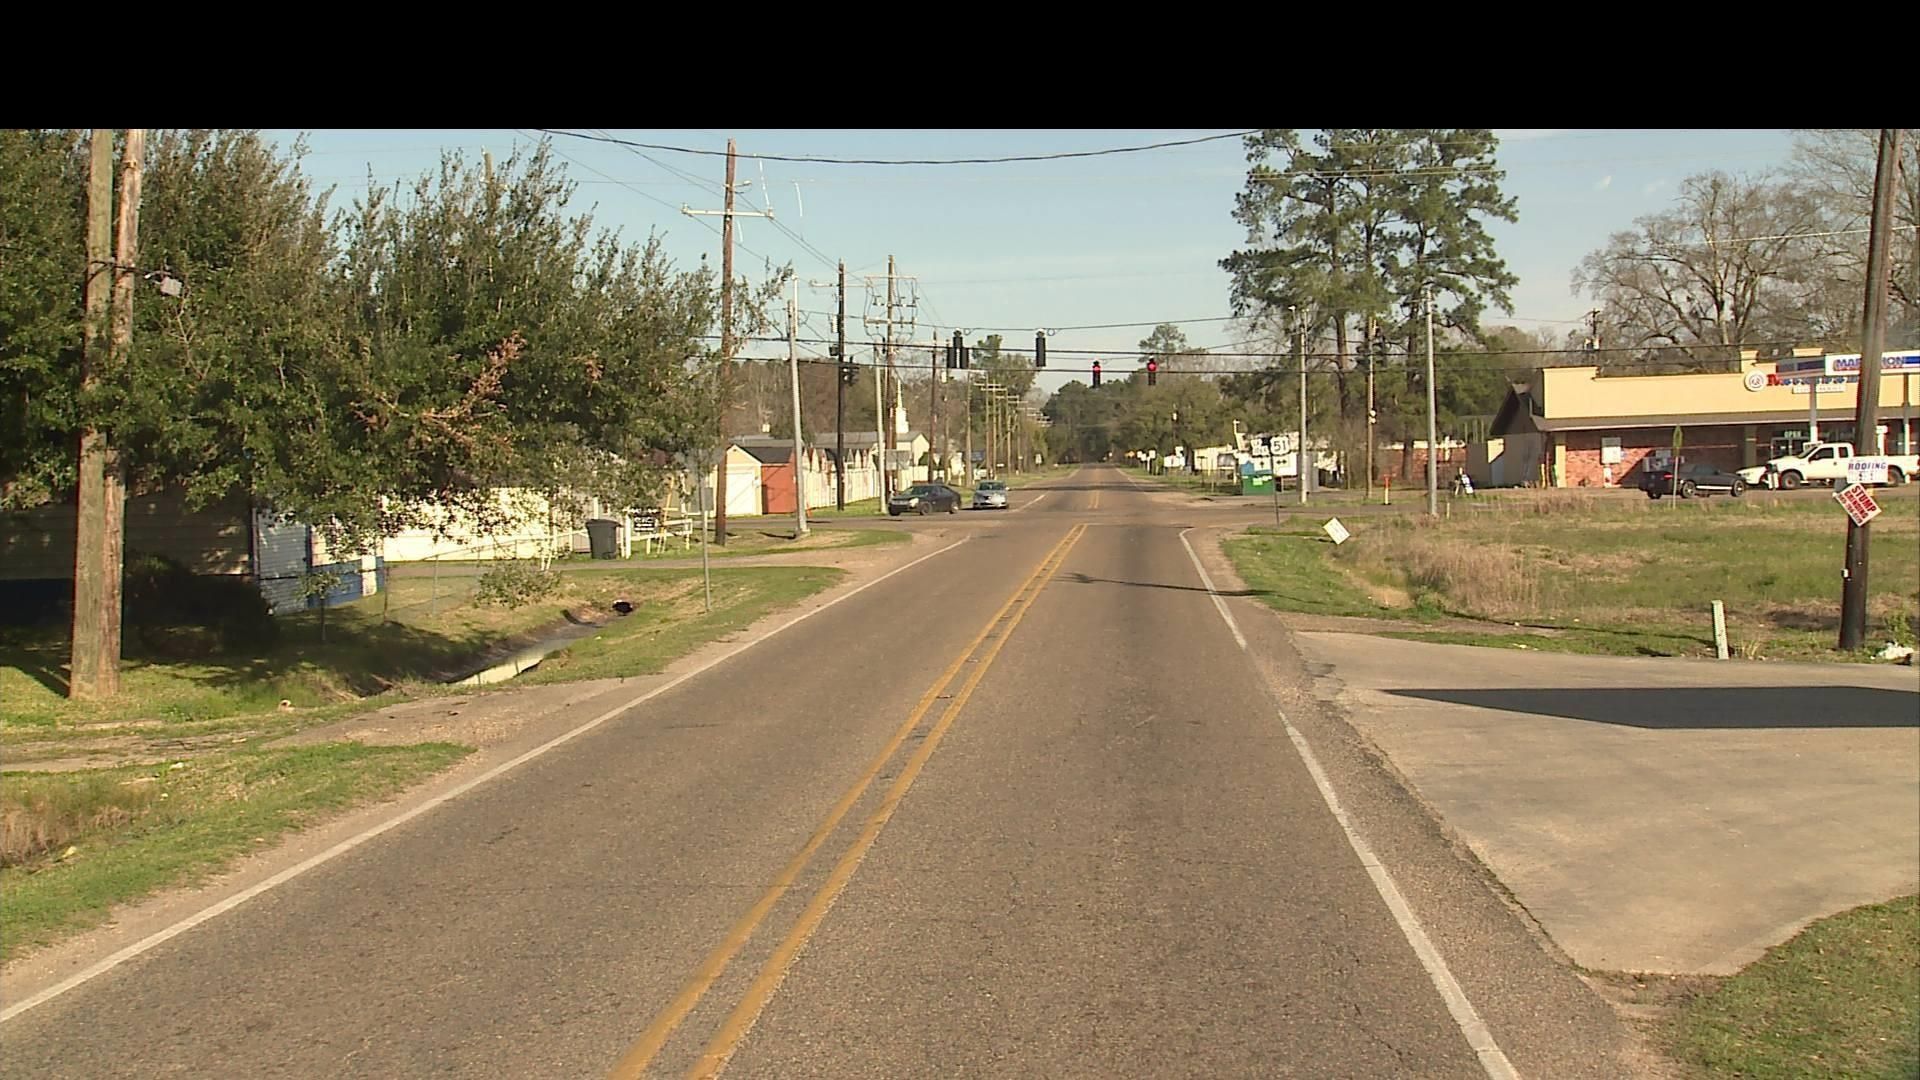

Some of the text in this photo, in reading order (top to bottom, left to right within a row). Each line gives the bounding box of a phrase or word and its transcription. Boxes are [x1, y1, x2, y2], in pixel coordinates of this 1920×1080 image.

[1273, 440, 1287, 452] 51
[1848, 462, 1886, 470] ROOFING
[1844, 490, 1869, 519] GRINDING
[1852, 485, 1877, 512] STUMP
